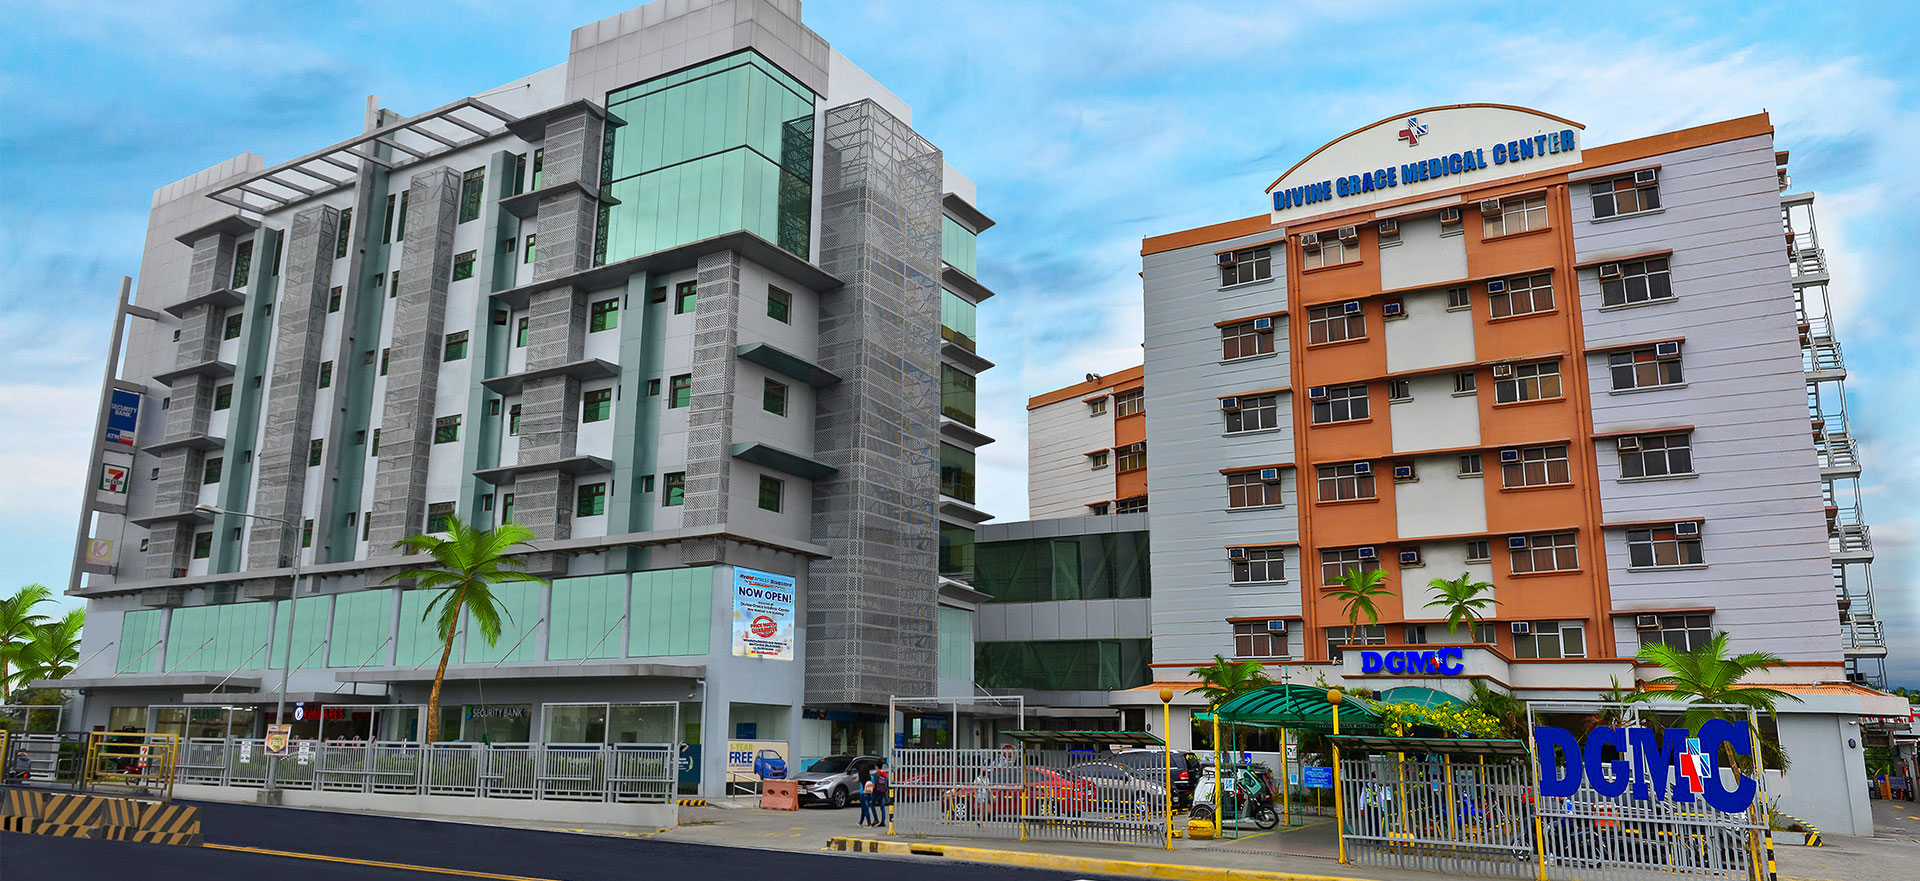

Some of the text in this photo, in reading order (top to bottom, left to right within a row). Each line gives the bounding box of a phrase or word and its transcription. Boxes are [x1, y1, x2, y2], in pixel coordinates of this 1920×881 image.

[1273, 129, 1576, 211] DIVINE GRACE MEDICAL CENTER
[111, 403, 137, 414] SECURITY
[114, 410, 132, 418] BANK
[738, 586, 792, 603] NOW OPEN!
[1361, 647, 1465, 676] DGMC
[472, 707, 524, 718] SECURITY BANK
[730, 743, 753, 752] 1-YEAR
[729, 751, 753, 764] FREE
[1534, 719, 1757, 814] DGMC
